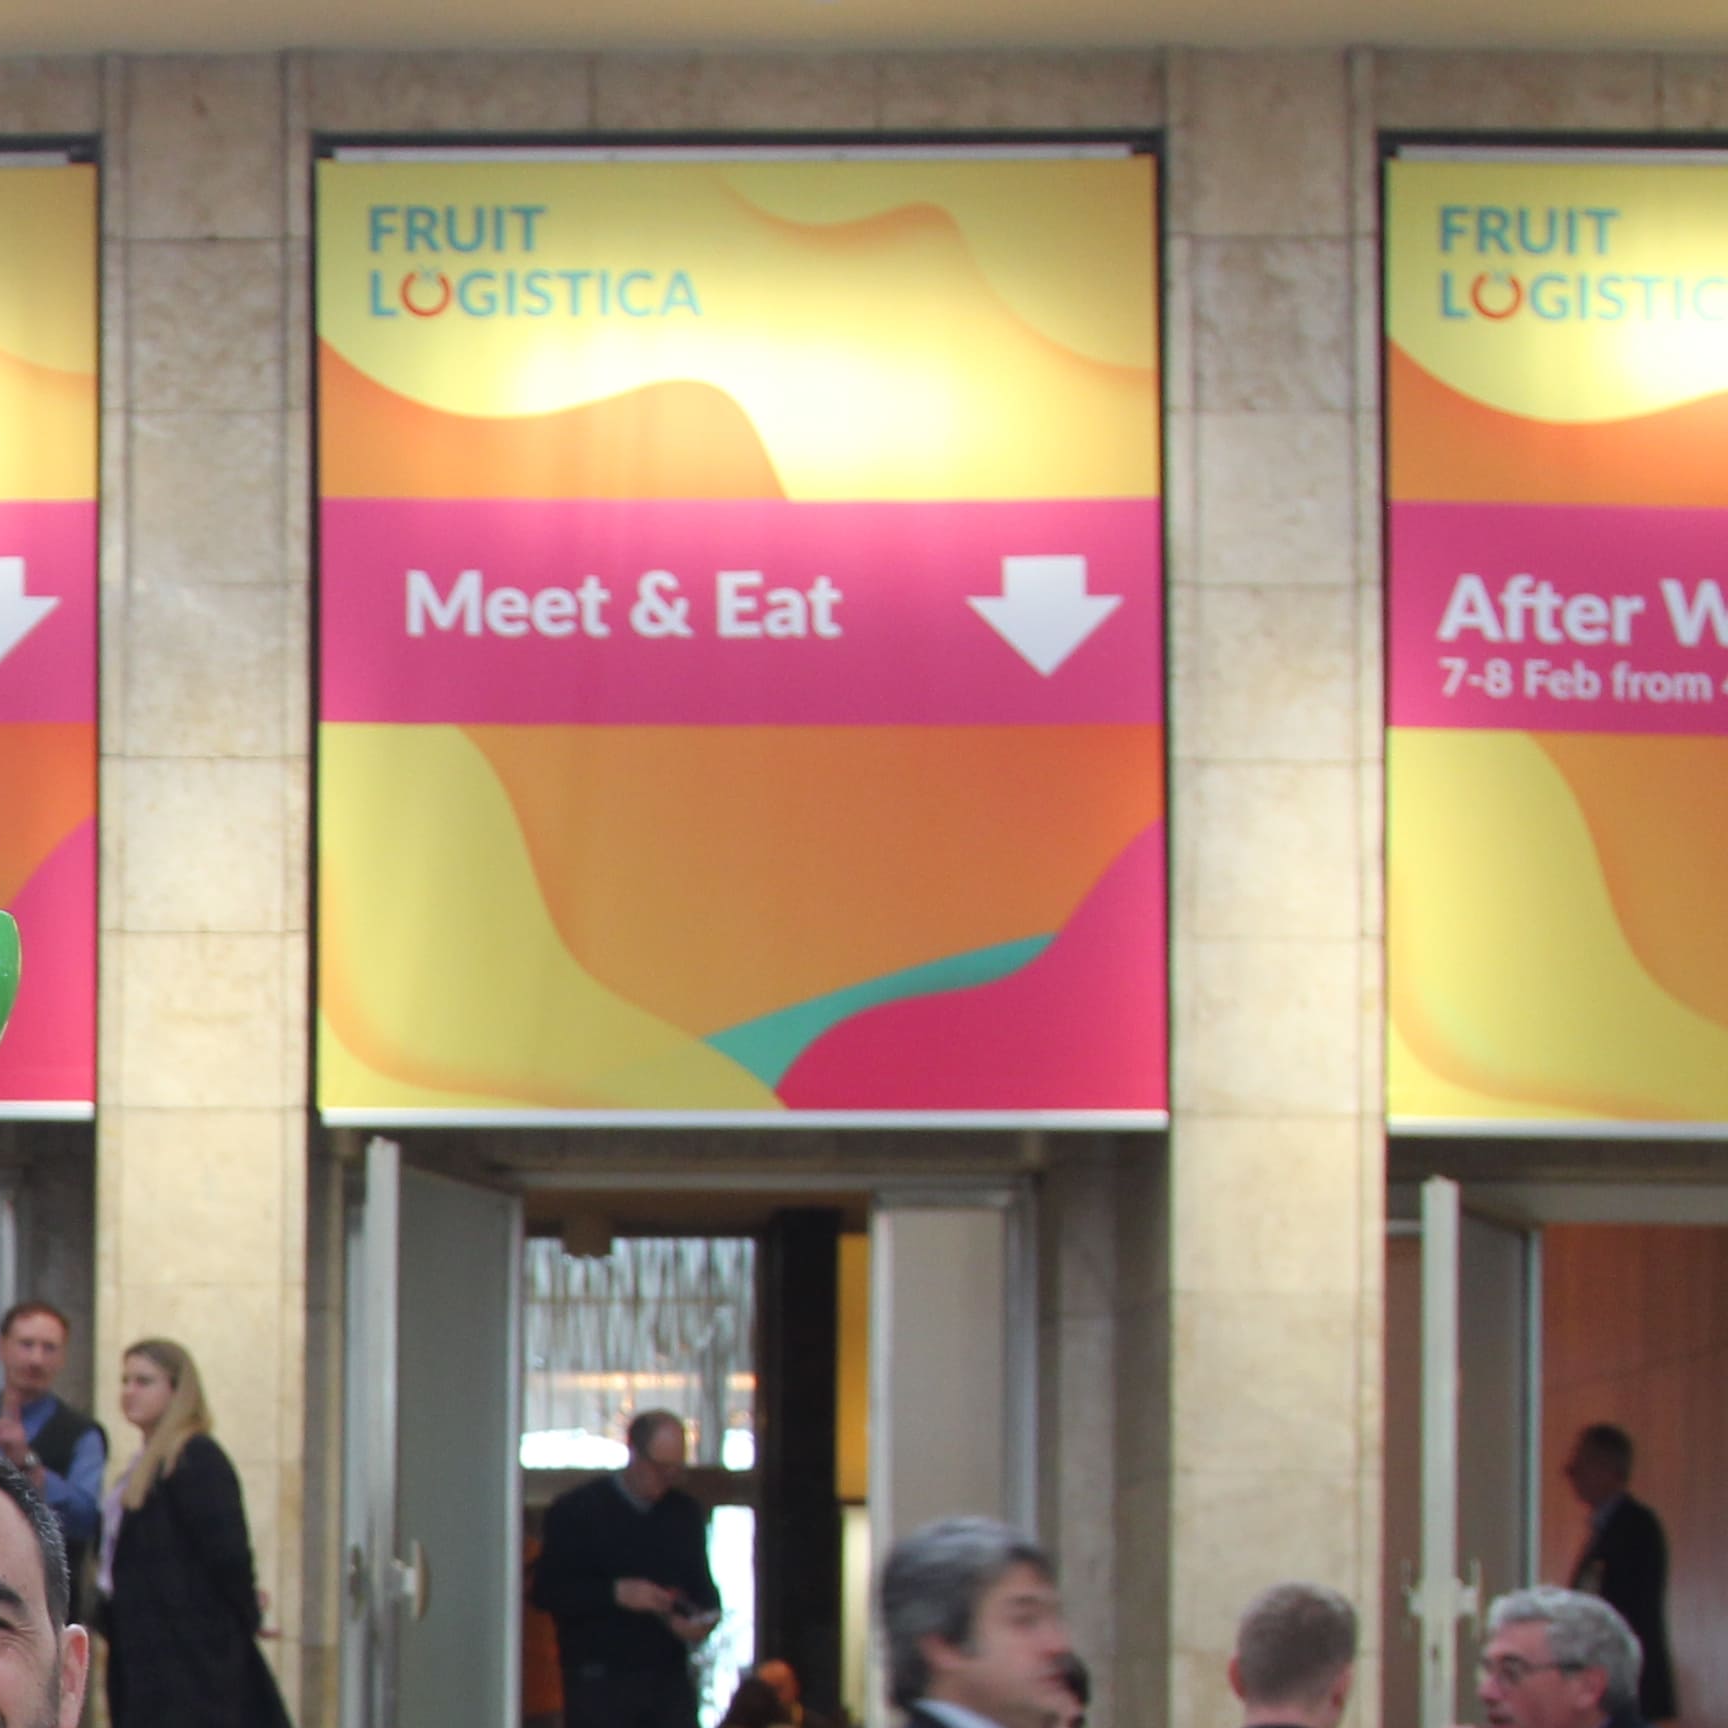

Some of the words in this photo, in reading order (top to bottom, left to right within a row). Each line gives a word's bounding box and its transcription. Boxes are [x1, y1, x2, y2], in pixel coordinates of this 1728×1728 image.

[367, 205, 545, 253] FRUIT
[1437, 204, 1620, 255] FRUIT
[368, 267, 703, 319] LOGISTICA
[405, 570, 611, 637] Meet
[630, 570, 694, 637] &
[715, 571, 843, 637] Eat
[1436, 573, 1645, 645] After
[1439, 656, 1512, 699] 7-8
[1524, 658, 1602, 701] Feb
[1611, 659, 1714, 703] from
